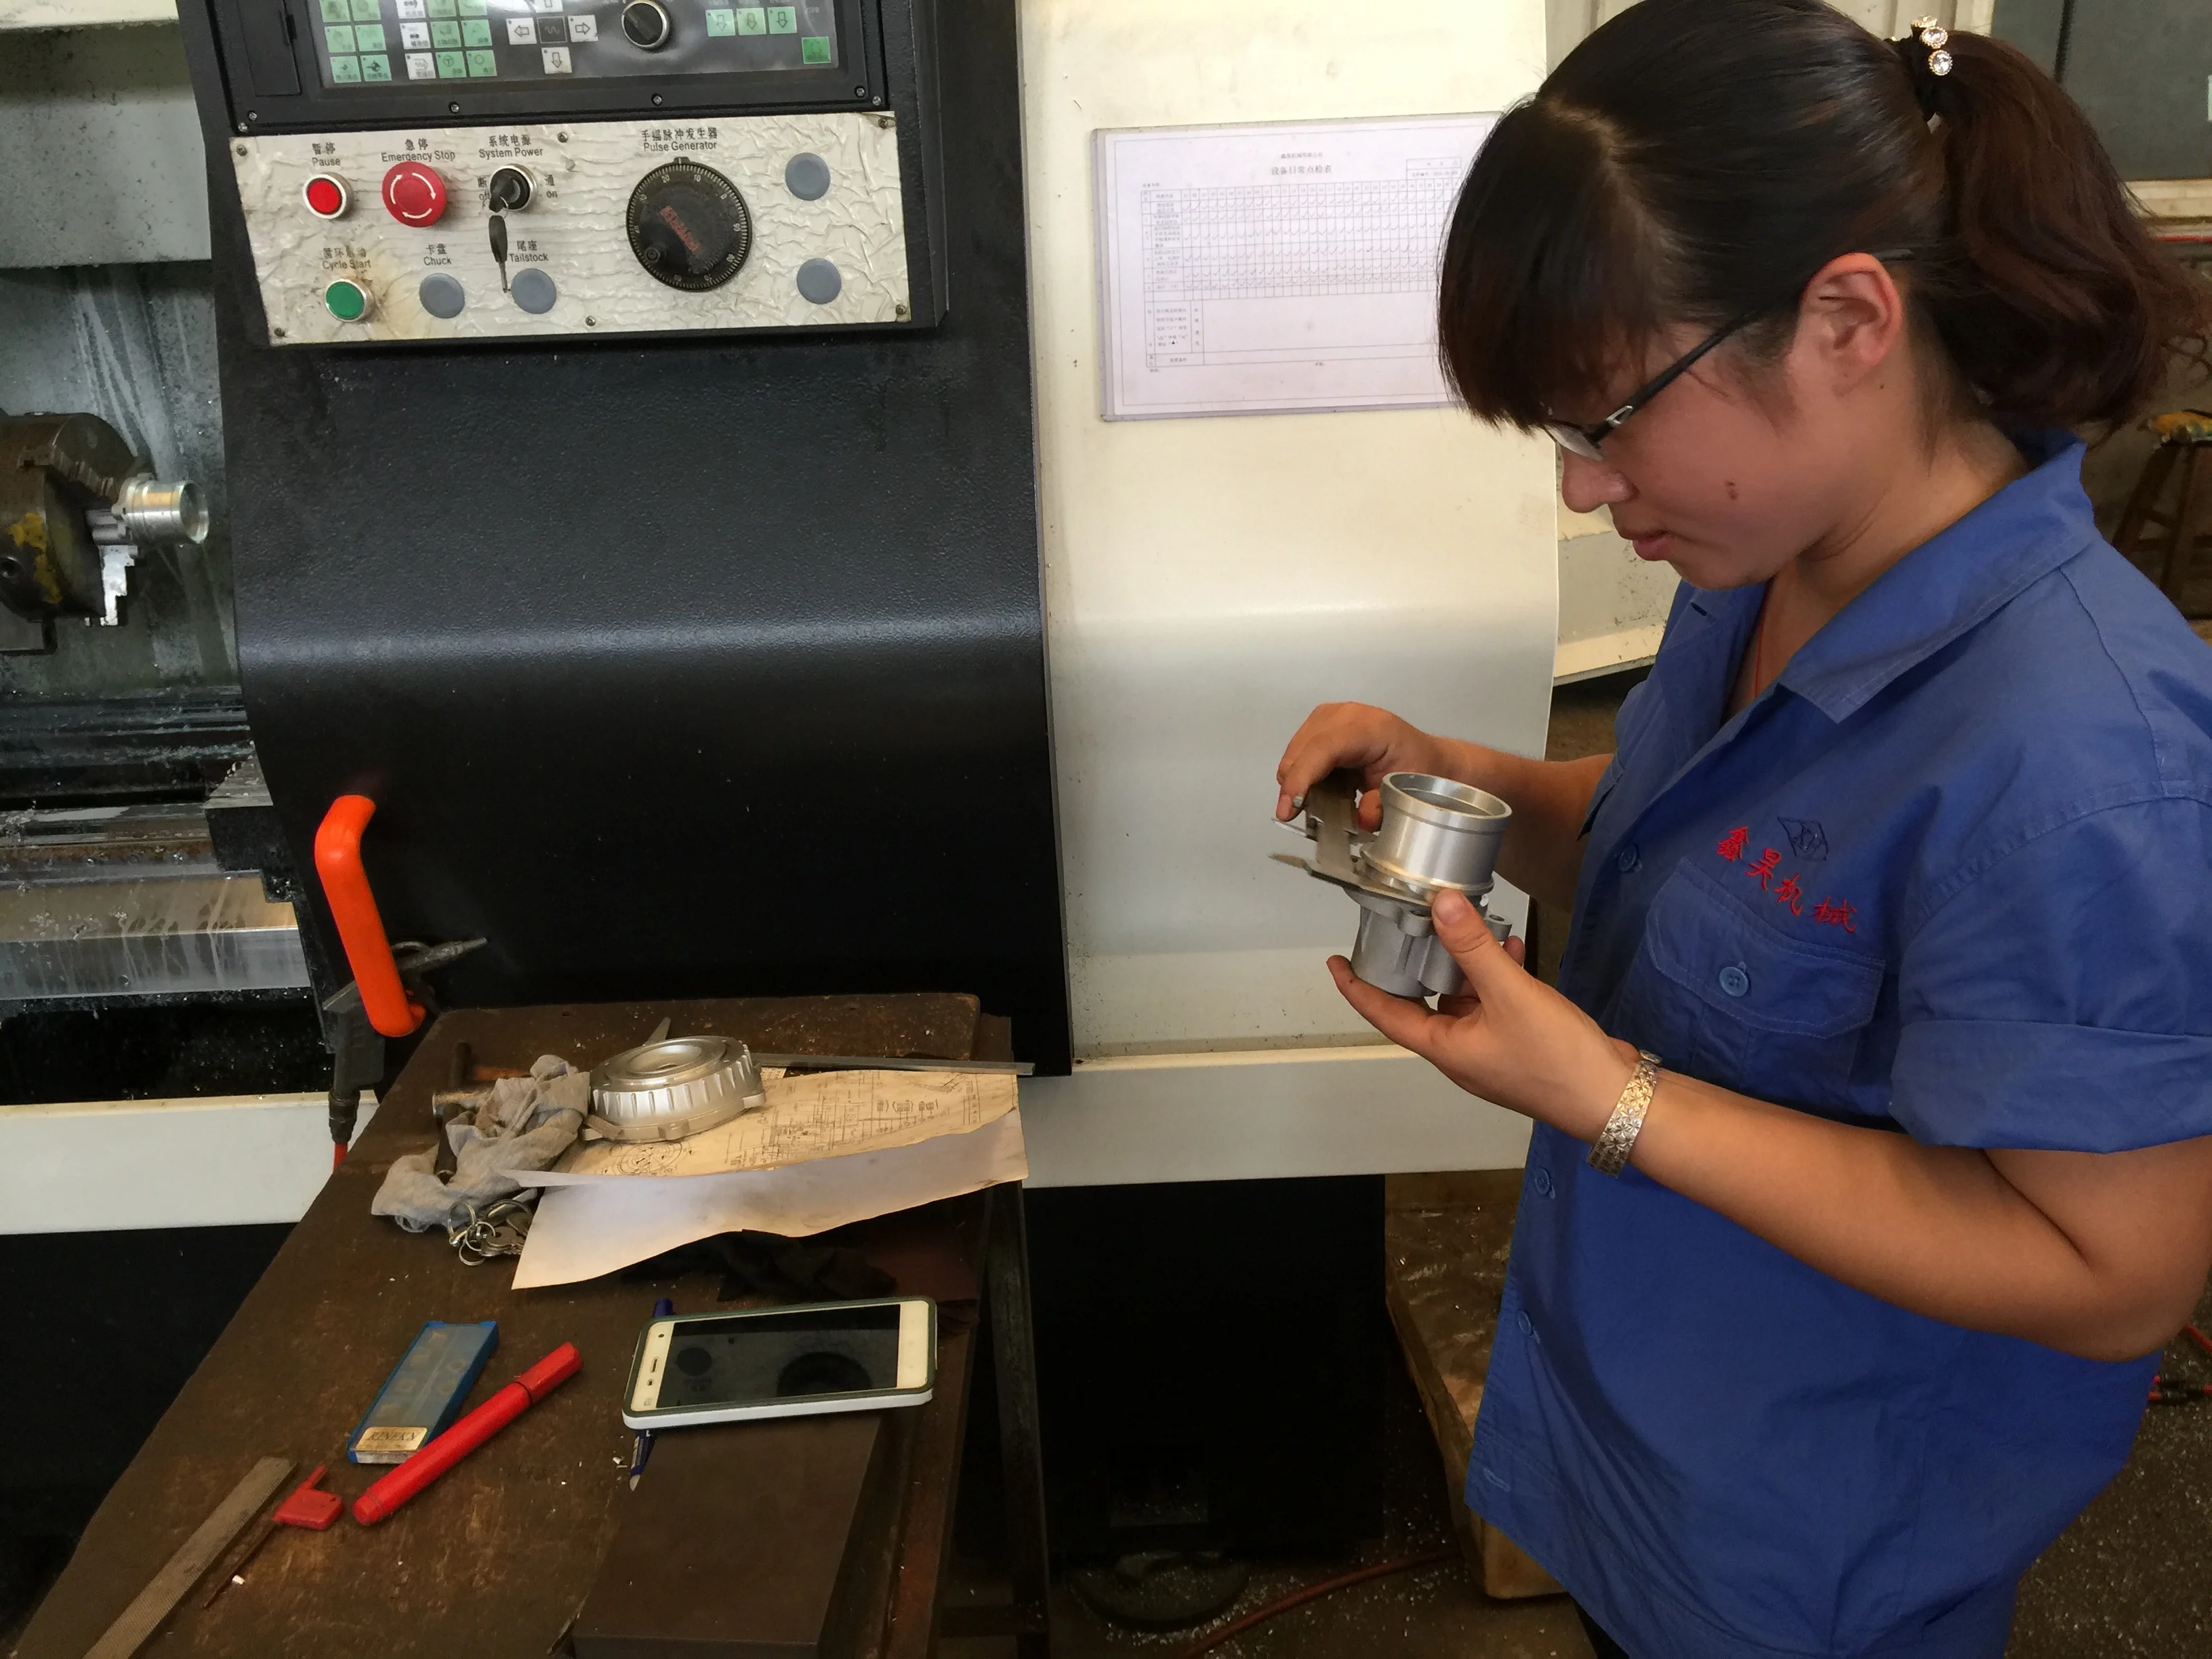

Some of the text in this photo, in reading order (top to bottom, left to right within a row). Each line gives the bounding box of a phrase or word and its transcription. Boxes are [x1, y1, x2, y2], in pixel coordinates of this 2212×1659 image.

[488, 134, 532, 147] 系统电源
[641, 127, 718, 142] 手摇脉冲发生器
[312, 141, 336, 155] 暂停
[405, 138, 428, 151] 急停
[643, 141, 717, 152] Pulse Generator
[382, 150, 455, 163] Emergency Stop
[478, 146, 543, 159] System Power
[312, 156, 341, 167] Pause
[693, 174, 701, 182] 10
[546, 190, 558, 199] on
[426, 243, 447, 255] 卡盘
[516, 240, 538, 251] 尾座
[423, 255, 452, 266] Chuck
[509, 252, 549, 264] Tailstock
[322, 259, 371, 271] Cycle Start
